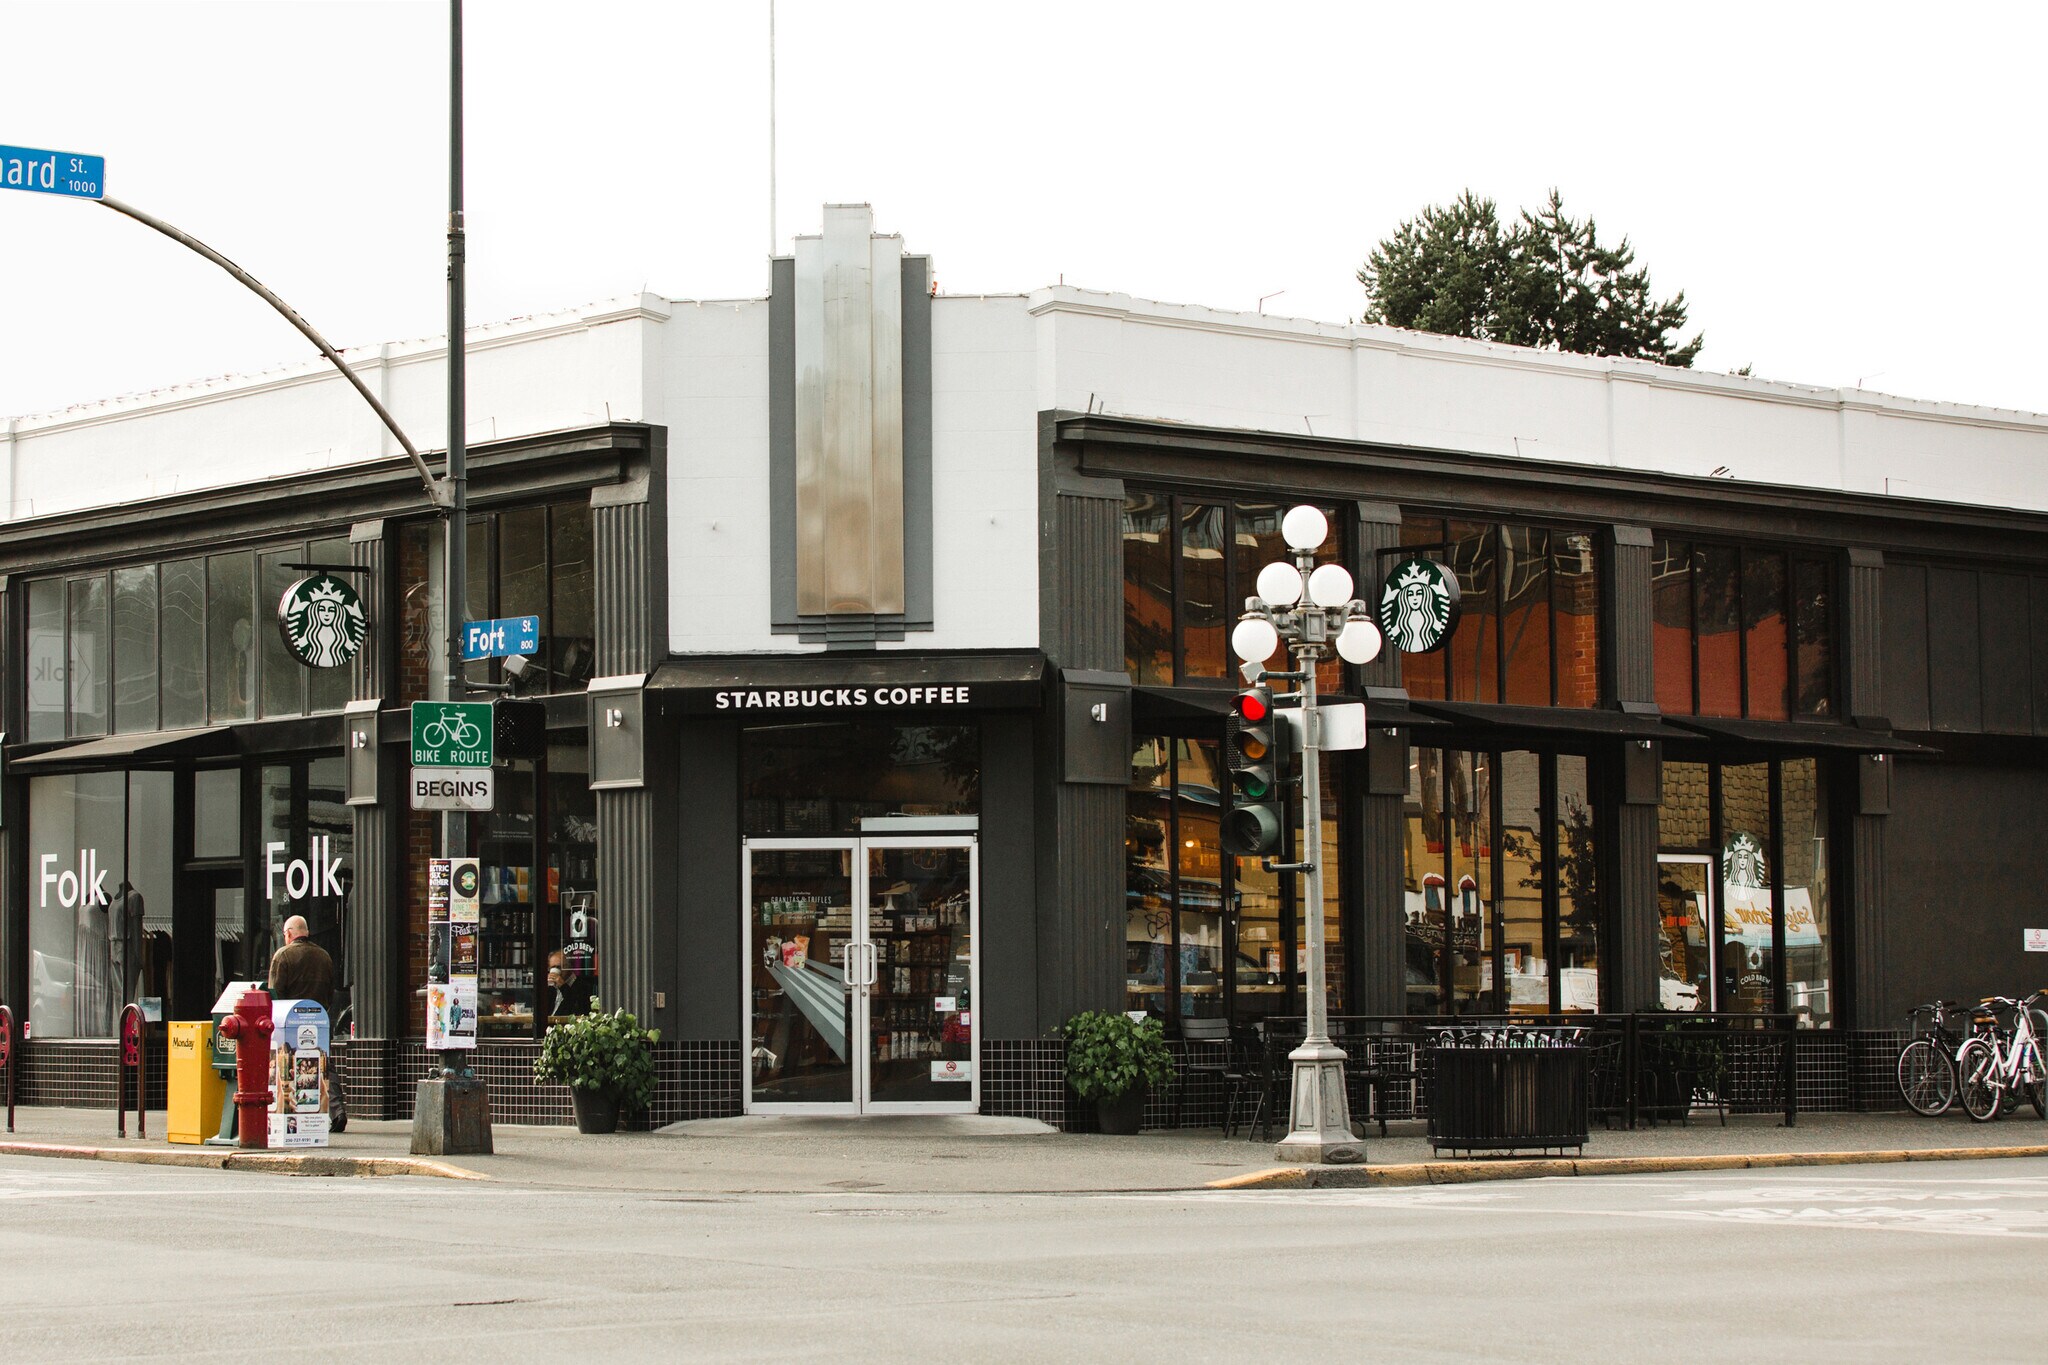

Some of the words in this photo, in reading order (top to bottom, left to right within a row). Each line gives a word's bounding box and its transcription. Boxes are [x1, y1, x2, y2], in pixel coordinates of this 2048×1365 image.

[0, 155, 56, 189] ard
[70, 158, 88, 174] St.
[69, 180, 97, 194] 1000
[469, 626, 505, 652] Fort
[522, 619, 533, 633] St.
[520, 640, 534, 650] 800
[715, 688, 868, 709] STARBUCKS
[874, 686, 970, 705] COFFEE
[415, 750, 441, 763] BIKE
[450, 750, 489, 764] ROUTE
[416, 780, 488, 797] BEGINS
[266, 834, 344, 900] Folk
[40, 848, 108, 908] Folk
[808, 896, 832, 905] TRIFLES
[563, 943, 578, 955] COLD
[580, 943, 594, 954] BREW
[1740, 974, 1755, 985] COLD
[1756, 974, 1771, 984] BREW
[172, 1037, 195, 1050] Monday
